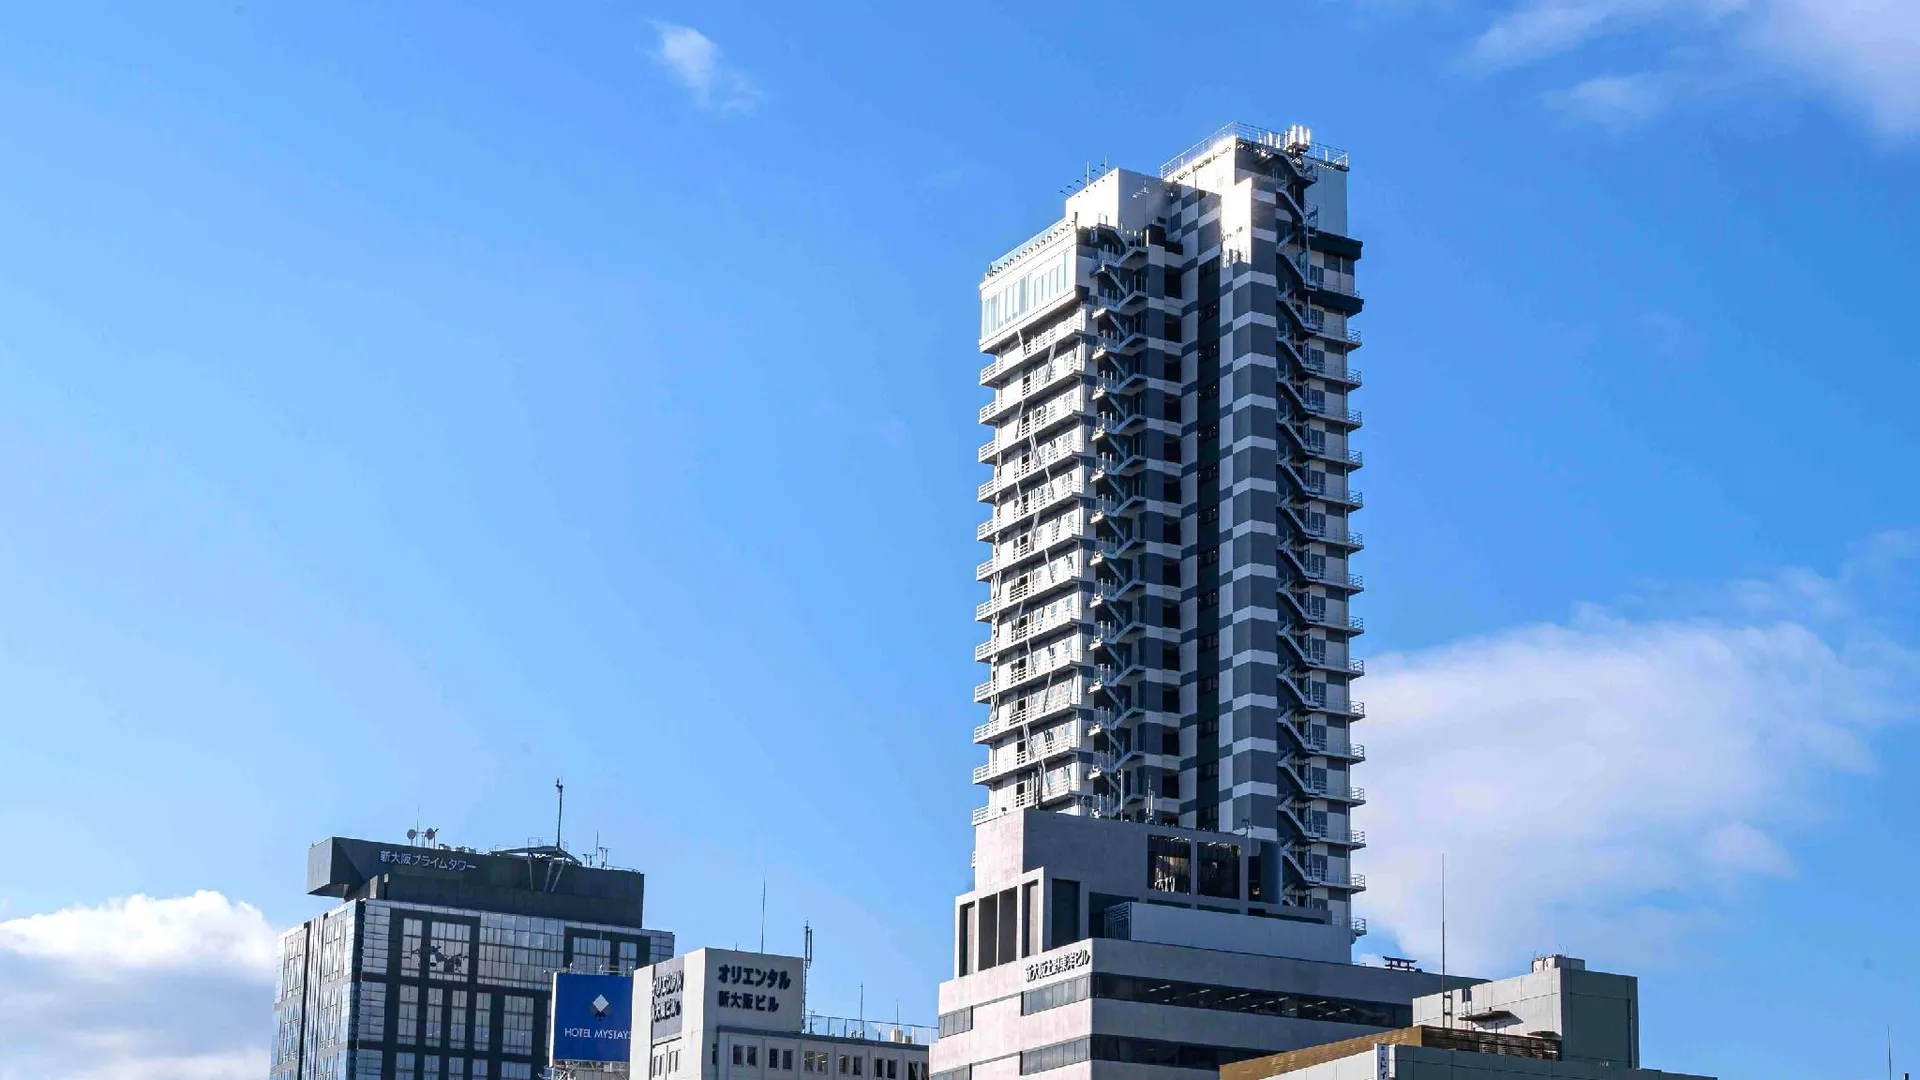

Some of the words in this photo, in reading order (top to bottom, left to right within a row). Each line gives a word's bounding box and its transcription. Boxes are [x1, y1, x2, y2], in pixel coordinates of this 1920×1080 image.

[380, 850, 477, 871] 新大阪プライムタワー
[718, 964, 791, 990] オリエンタル
[718, 990, 780, 1012] 新大阪ビル
[564, 1027, 592, 1038] HOTEL
